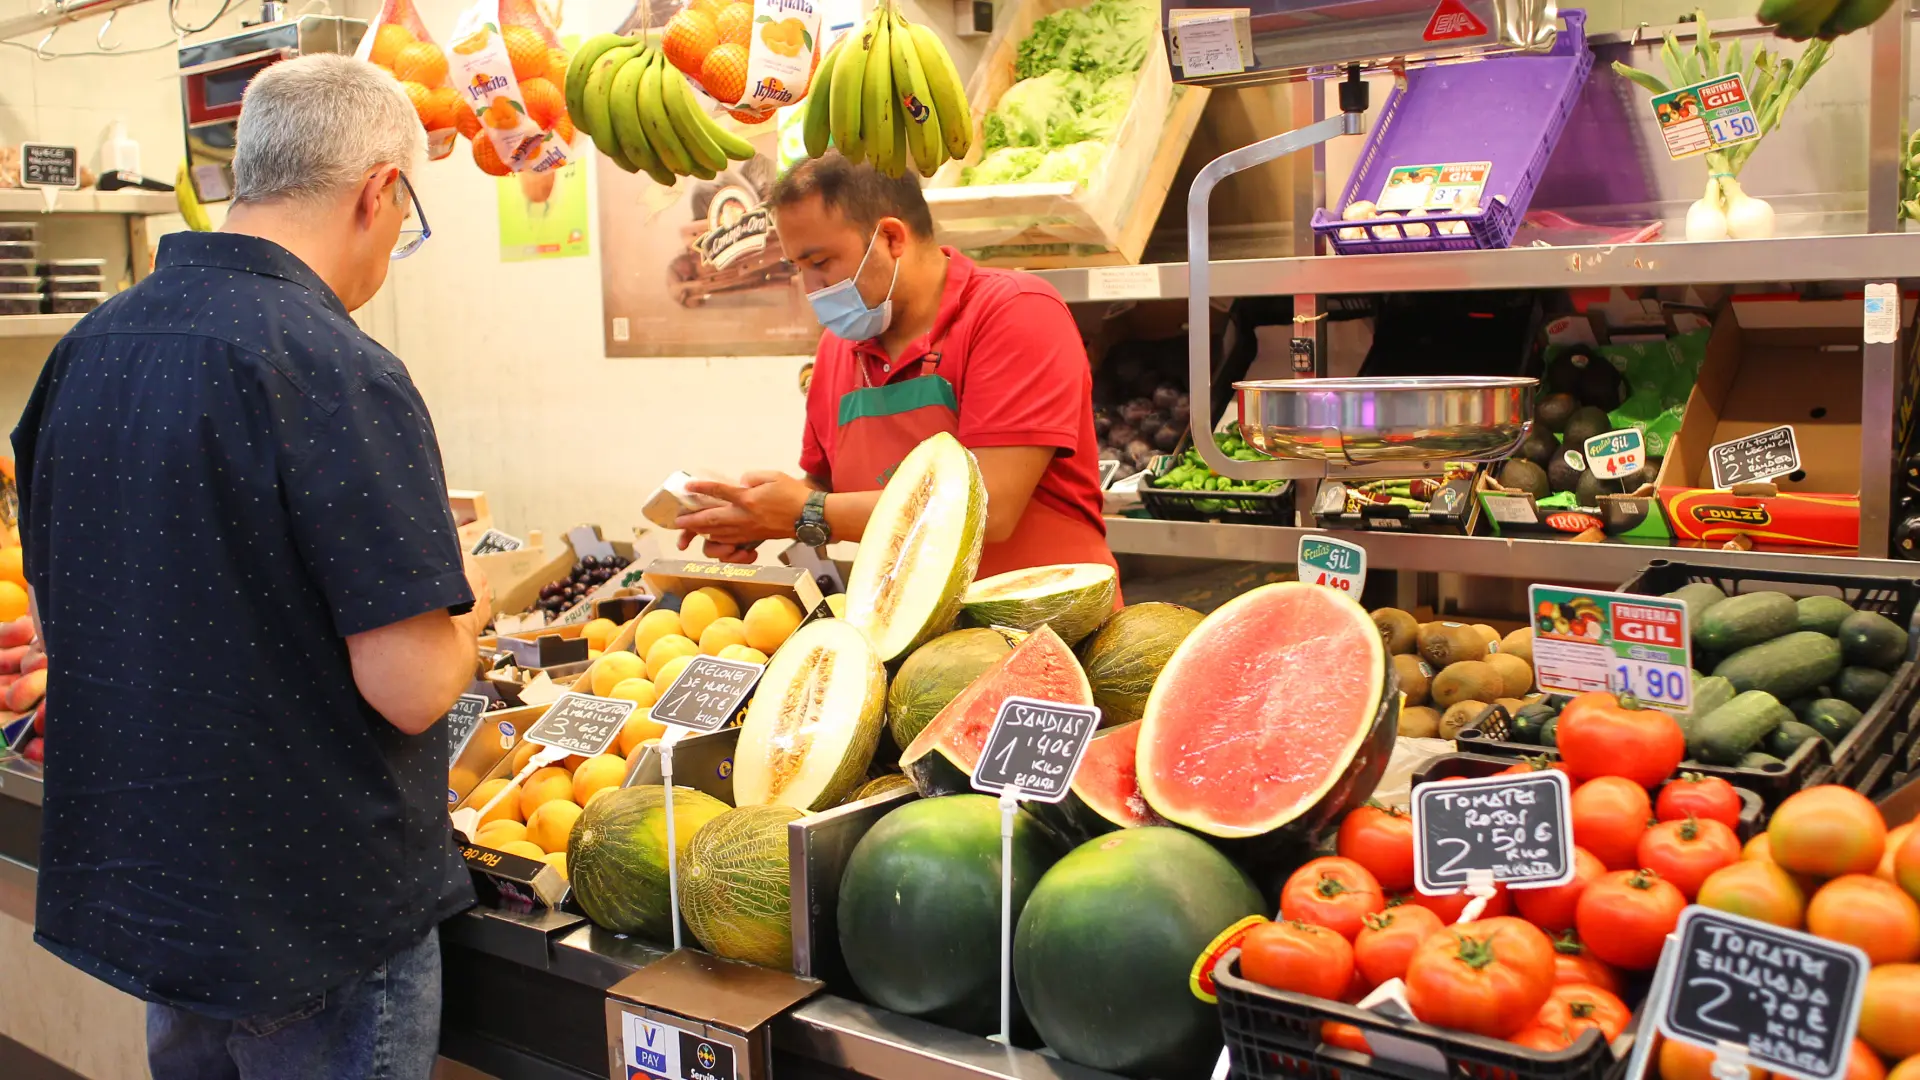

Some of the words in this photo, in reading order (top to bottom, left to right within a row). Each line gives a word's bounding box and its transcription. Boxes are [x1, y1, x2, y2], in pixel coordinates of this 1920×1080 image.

[1702, 80, 1738, 96] FRUTERIA
[1708, 91, 1740, 106] GIL
[1449, 171, 1473, 182] GIL
[1610, 435, 1629, 452] Gil
[1709, 509, 1764, 520] DULZE
[1303, 544, 1331, 560] Frutas
[1325, 548, 1352, 570] Gil
[1615, 605, 1678, 623] FRUTERIA
[1620, 621, 1676, 643] GIL
[681, 676, 701, 688] DE
[694, 709, 720, 725] KILO
[1006, 706, 1084, 737] SANDIAS
[1031, 759, 1064, 775] KILO
[463, 847, 480, 860] de
[477, 852, 502, 868] Flor
[641, 1023, 657, 1048] V
[1766, 1019, 1825, 1049] KILO
[642, 1050, 660, 1068] PAY
